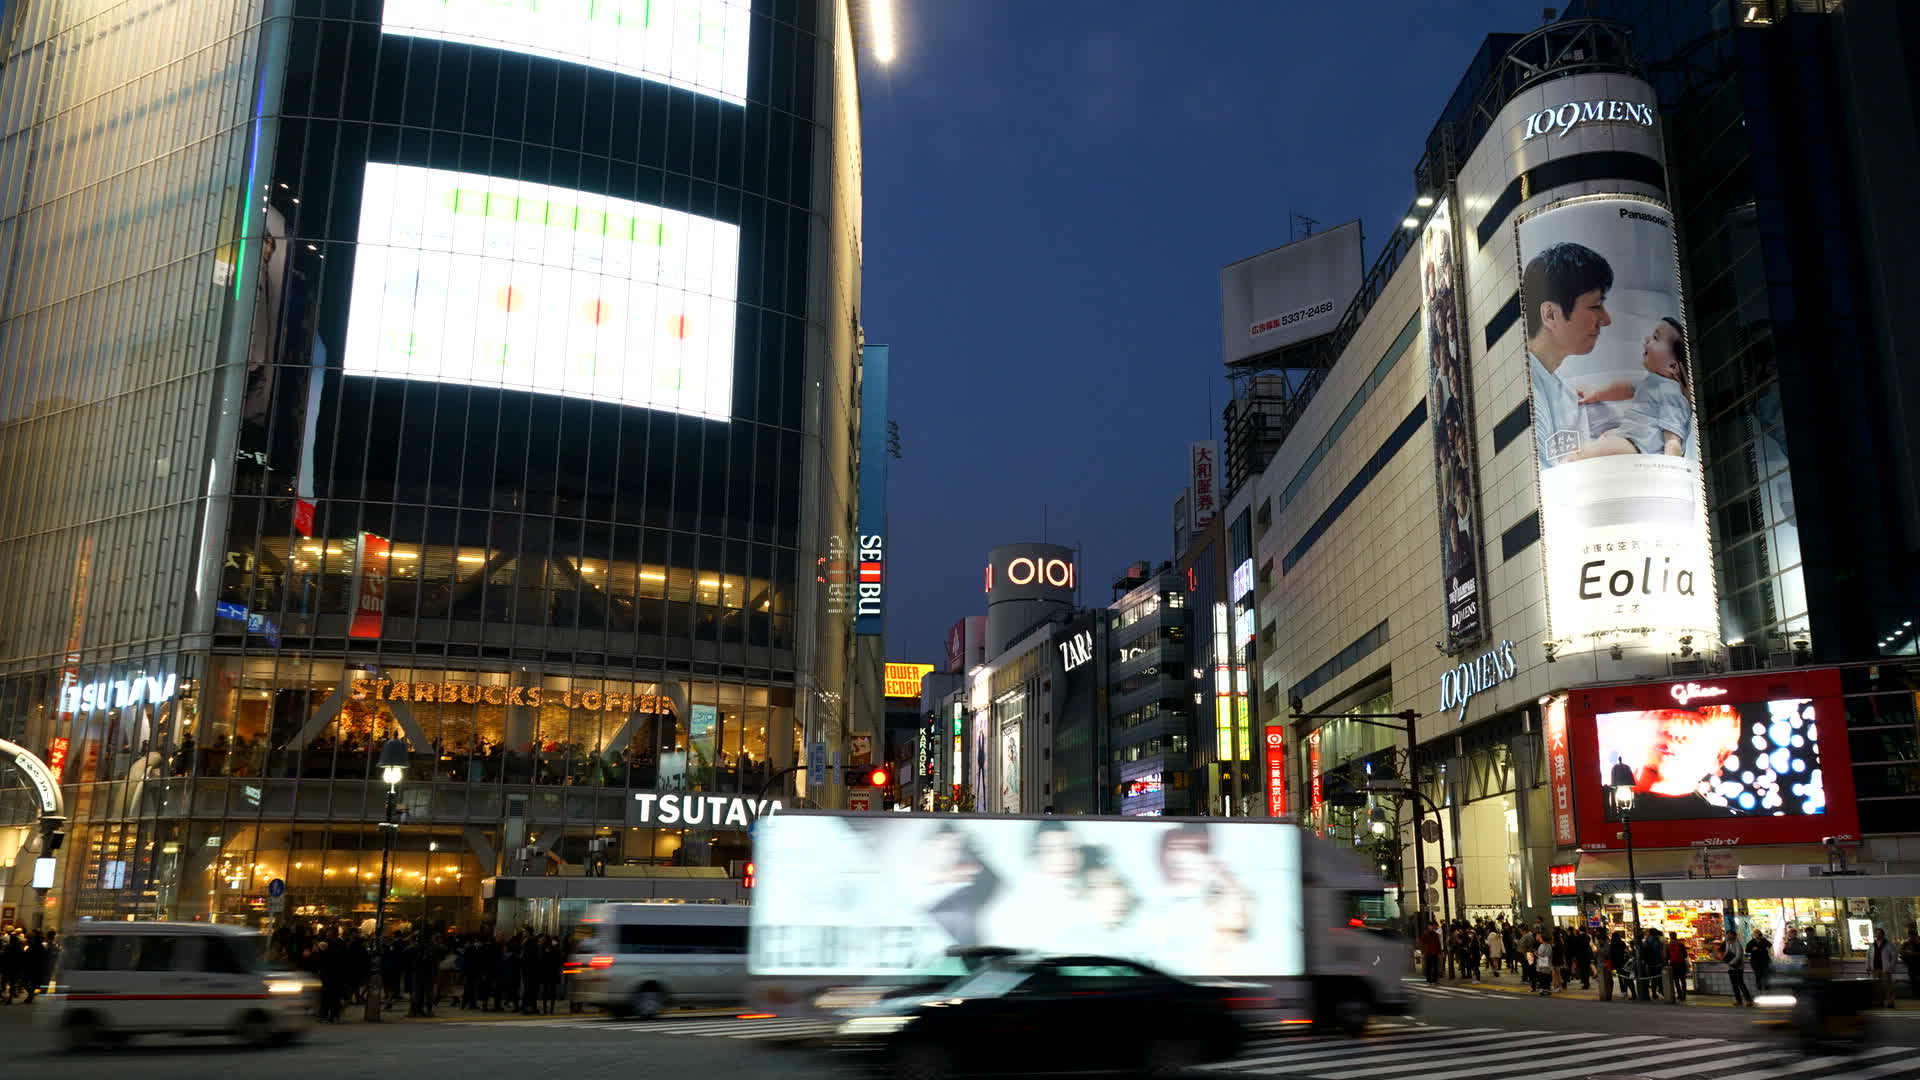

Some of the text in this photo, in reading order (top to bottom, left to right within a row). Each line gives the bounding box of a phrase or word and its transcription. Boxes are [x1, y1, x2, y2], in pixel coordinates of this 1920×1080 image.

[1619, 208, 1670, 228] Panasonic
[1281, 302, 1333, 326] 5337-2468
[859, 535, 882, 616] SEIBU
[1579, 557, 1695, 600] Eolia
[1060, 630, 1093, 672] ZARA
[350, 679, 545, 707] STARBUCKS
[884, 680, 922, 696] ECORD
[919, 728, 927, 776] KARAOKE
